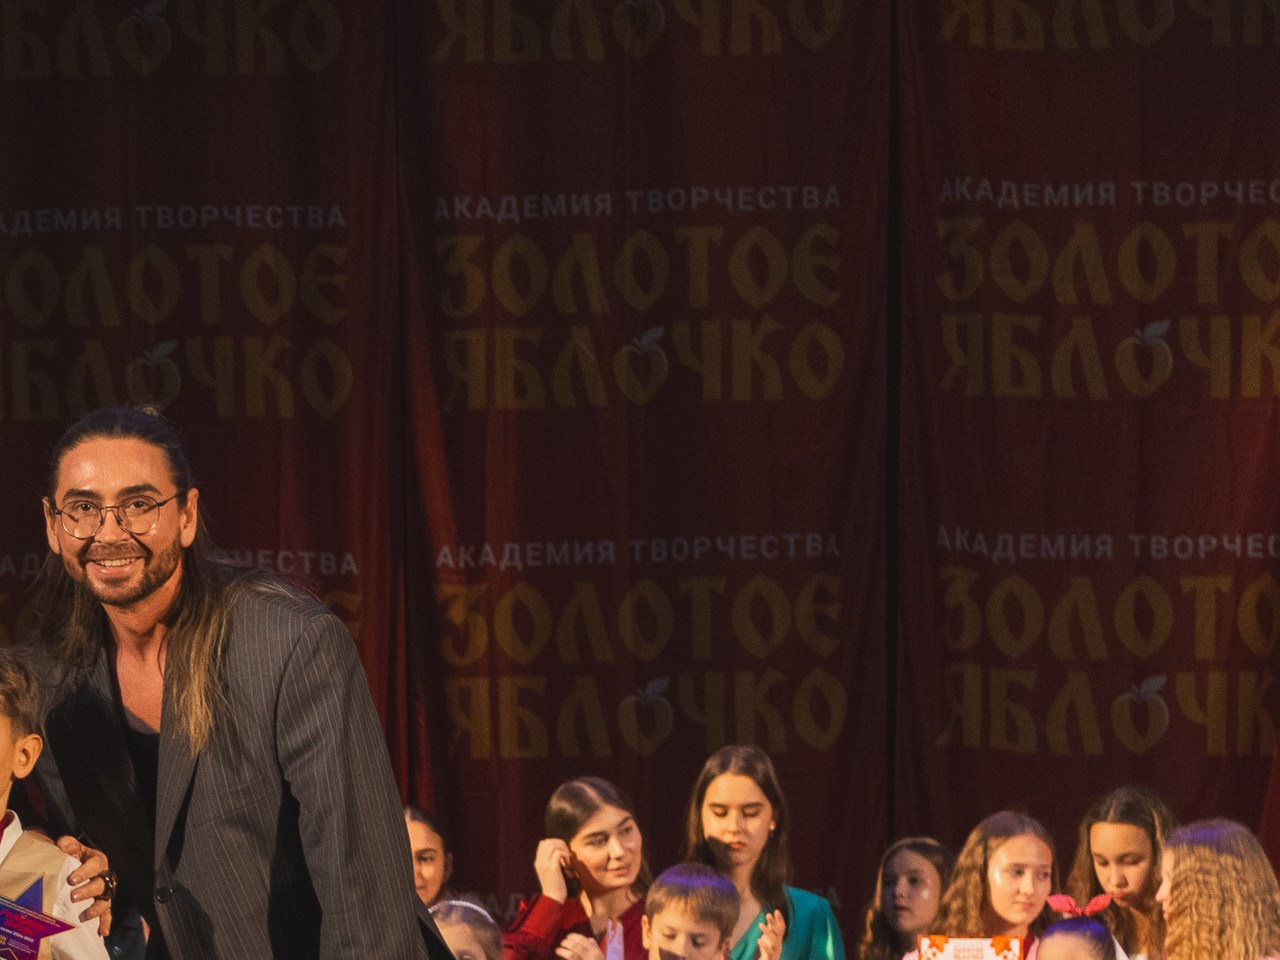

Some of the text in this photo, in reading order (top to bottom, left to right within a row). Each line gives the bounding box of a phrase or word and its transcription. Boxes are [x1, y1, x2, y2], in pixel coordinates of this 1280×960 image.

[434, 185, 842, 223] АКАДЕМИЯ ТВОРЧЕСТВА
[940, 177, 1117, 209] АКАДЕМИЯ
[138, 204, 346, 230] ТВОРЧЕСТВА
[435, 223, 841, 317] ЗОЛОТОЕ
[443, 315, 846, 413] ЯБЛОЧКО
[435, 532, 840, 572] АКАДЕМИЯ ТВОРЧЕСТВА
[936, 525, 1113, 562] АКАДЕМИЯ
[436, 572, 842, 666] ЗОЛОТОЕ
[446, 666, 849, 761] ЯБЛОЧКО
